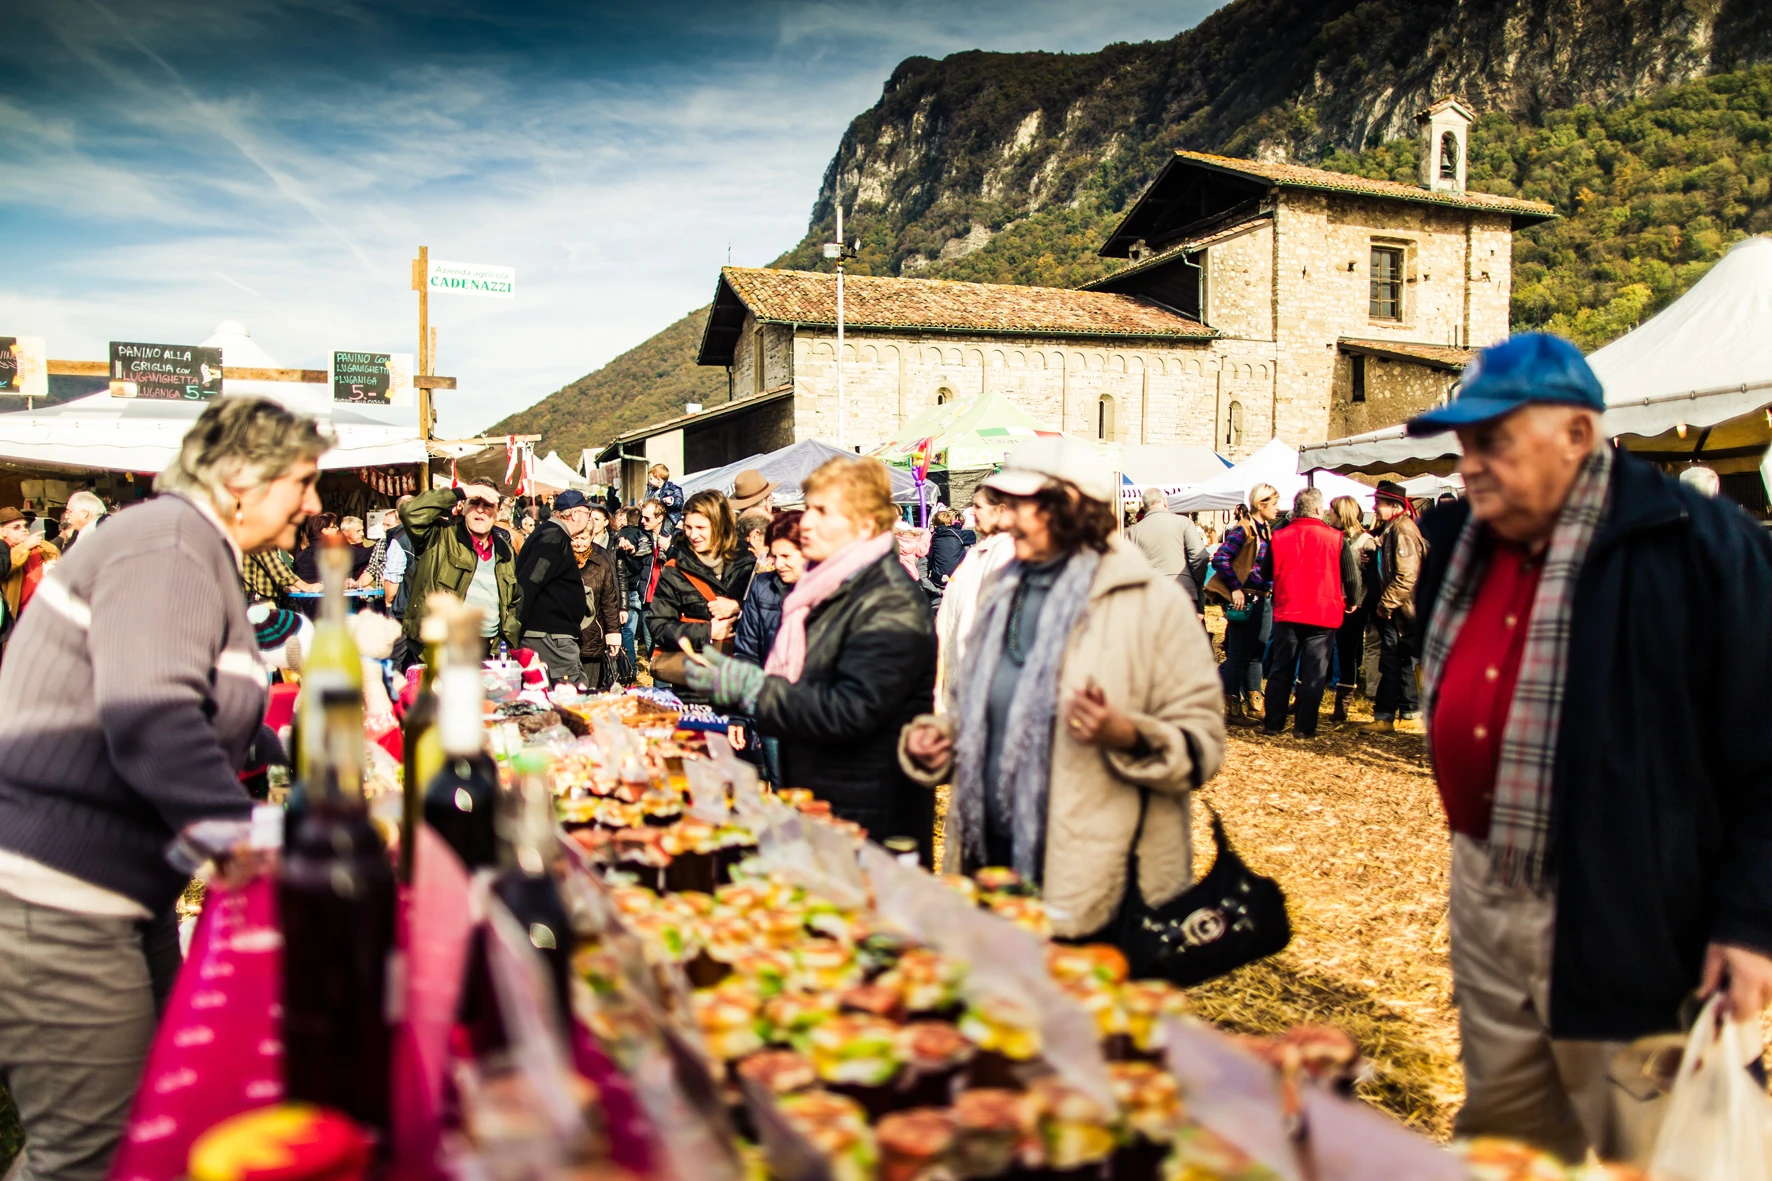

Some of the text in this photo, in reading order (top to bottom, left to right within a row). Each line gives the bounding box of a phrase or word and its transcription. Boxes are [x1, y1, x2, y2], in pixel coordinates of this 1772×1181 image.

[435, 266, 509, 280] Azienda agricola
[430, 276, 512, 293] CADENAZZI
[118, 345, 192, 361] PANINO ALLA
[336, 353, 371, 364] PANINO
[131, 361, 174, 373] GRIGLIA
[122, 370, 199, 385] LUGANIGHETTA
[339, 375, 377, 385] LUGANIGA
[137, 385, 181, 398] LUGANIGA
